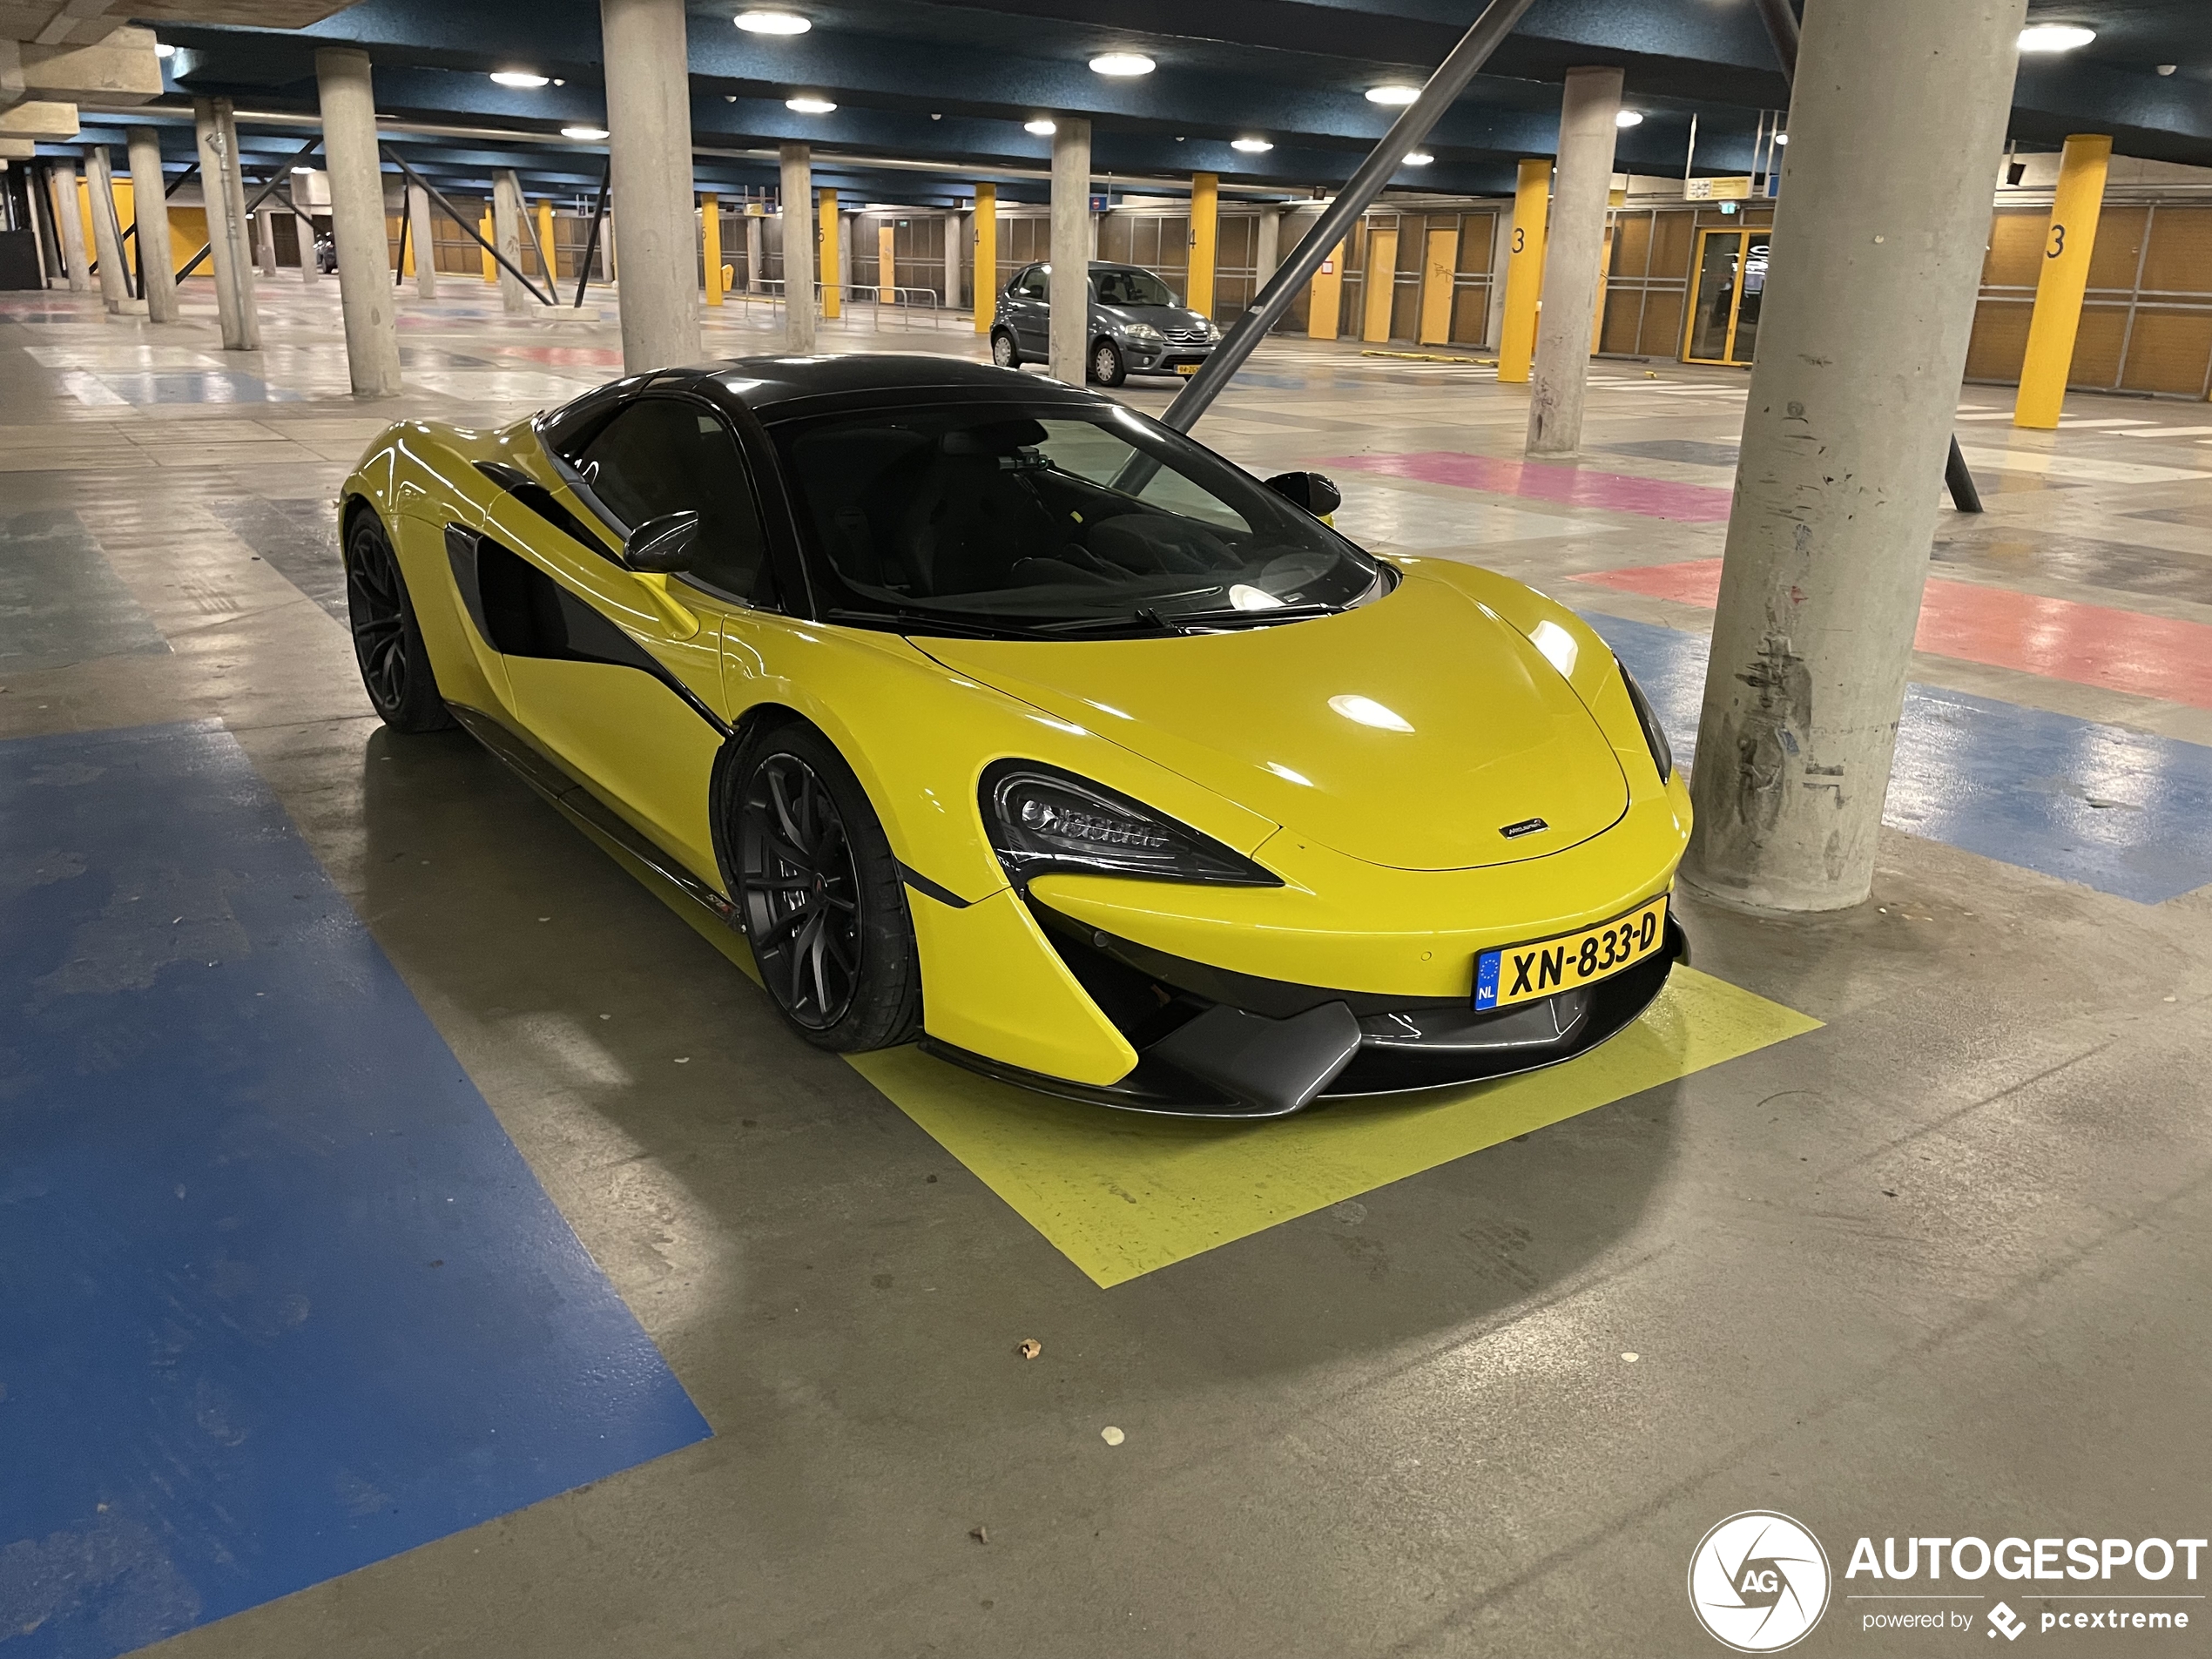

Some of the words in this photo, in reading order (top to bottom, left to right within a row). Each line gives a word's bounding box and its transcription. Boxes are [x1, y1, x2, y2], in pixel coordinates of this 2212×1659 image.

[1512, 227, 1524, 253] 3
[2047, 224, 2065, 259] 3
[1509, 912, 1656, 996] XN-833-D
[1479, 986, 1494, 1000] NL
